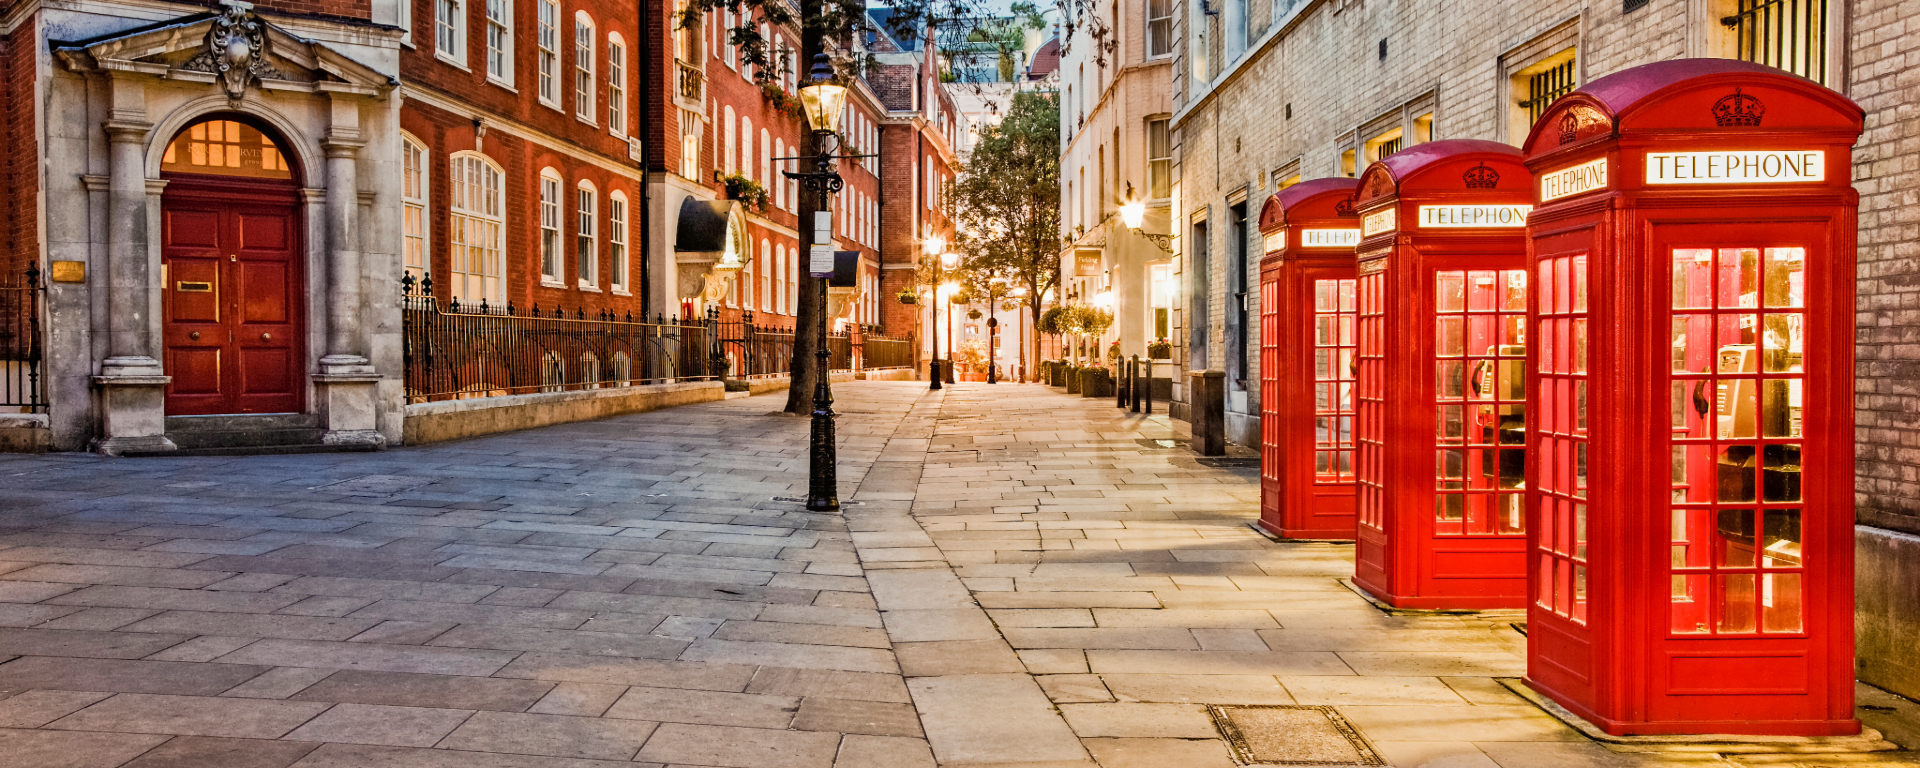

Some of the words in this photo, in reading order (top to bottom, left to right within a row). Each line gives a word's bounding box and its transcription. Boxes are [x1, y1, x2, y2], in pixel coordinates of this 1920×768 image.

[1653, 152, 1818, 179] TELEPHONE
[1544, 161, 1606, 199] TELEPHONE
[1365, 209, 1395, 234] TELEPHONE
[1423, 207, 1533, 224] TELEPHON
[1078, 256, 1098, 264] Fielding
